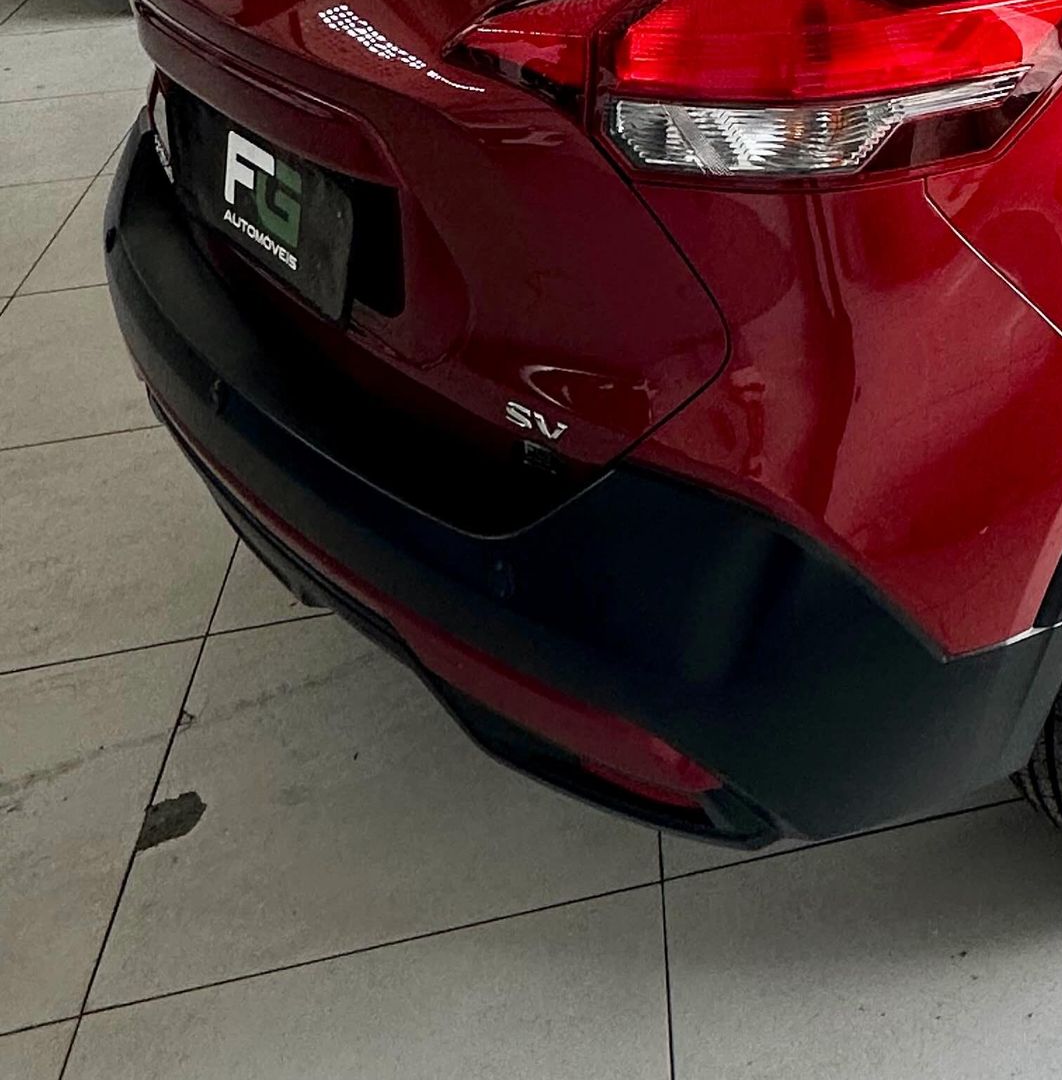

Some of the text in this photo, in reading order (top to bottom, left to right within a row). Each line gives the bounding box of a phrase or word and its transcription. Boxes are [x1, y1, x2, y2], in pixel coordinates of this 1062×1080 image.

[224, 130, 302, 248] FG
[223, 209, 298, 271] AUTOMÓVEIS
[505, 401, 569, 439] SV
